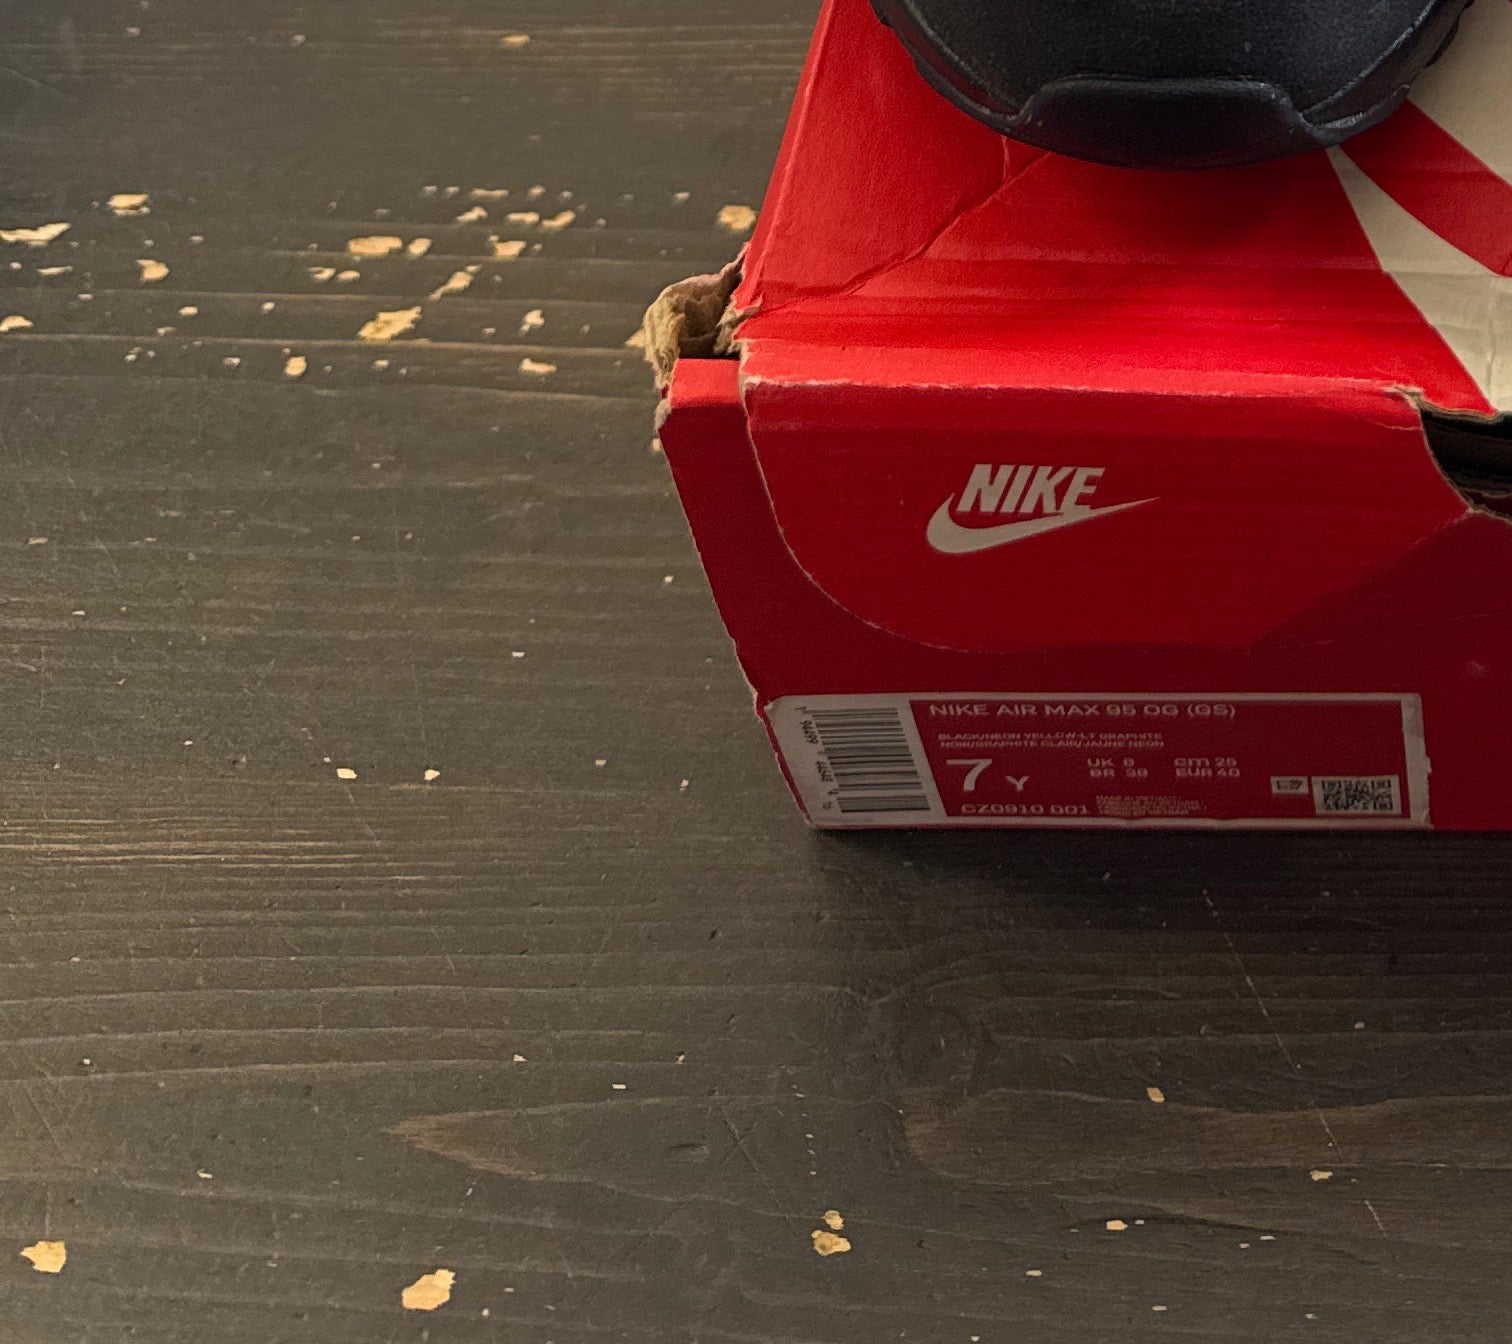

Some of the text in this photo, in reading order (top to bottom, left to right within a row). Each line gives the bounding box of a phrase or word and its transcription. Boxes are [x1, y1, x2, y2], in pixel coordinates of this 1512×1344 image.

[955, 463, 1106, 513] NIKE
[929, 702, 1237, 718] NIKE AIR MAX 95 OG (GS)
[1087, 757, 1114, 767] UK
[1173, 757, 1210, 767] cm
[946, 758, 1029, 792] 7 Y
